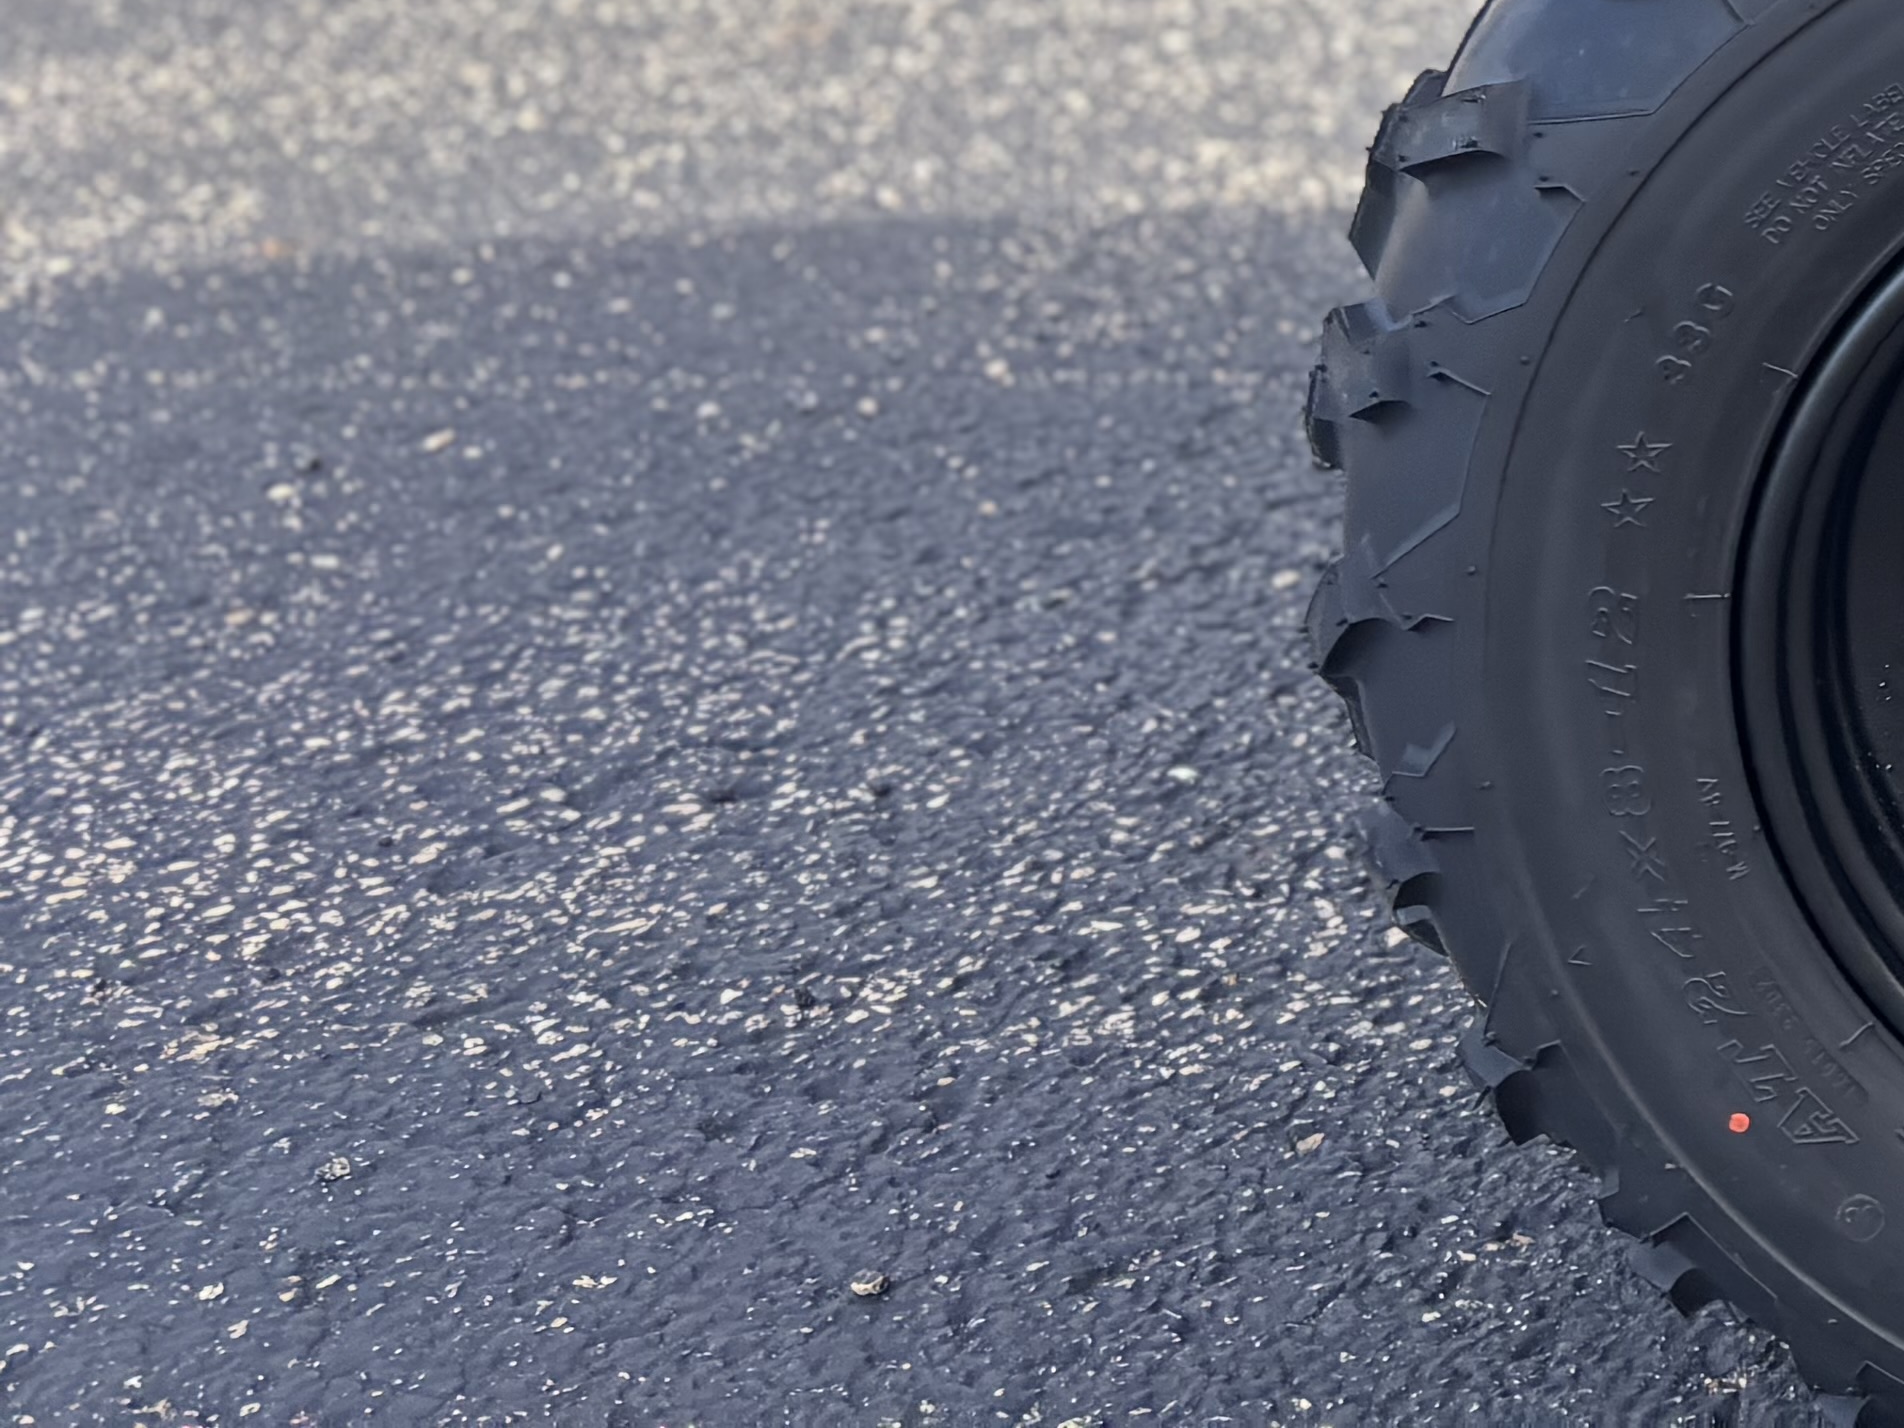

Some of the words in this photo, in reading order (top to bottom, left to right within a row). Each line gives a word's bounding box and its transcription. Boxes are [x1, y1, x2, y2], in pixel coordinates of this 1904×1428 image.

[1743, 192, 1778, 228] SEE
[1764, 214, 1793, 243] DO
[1791, 176, 1829, 213] NOT
